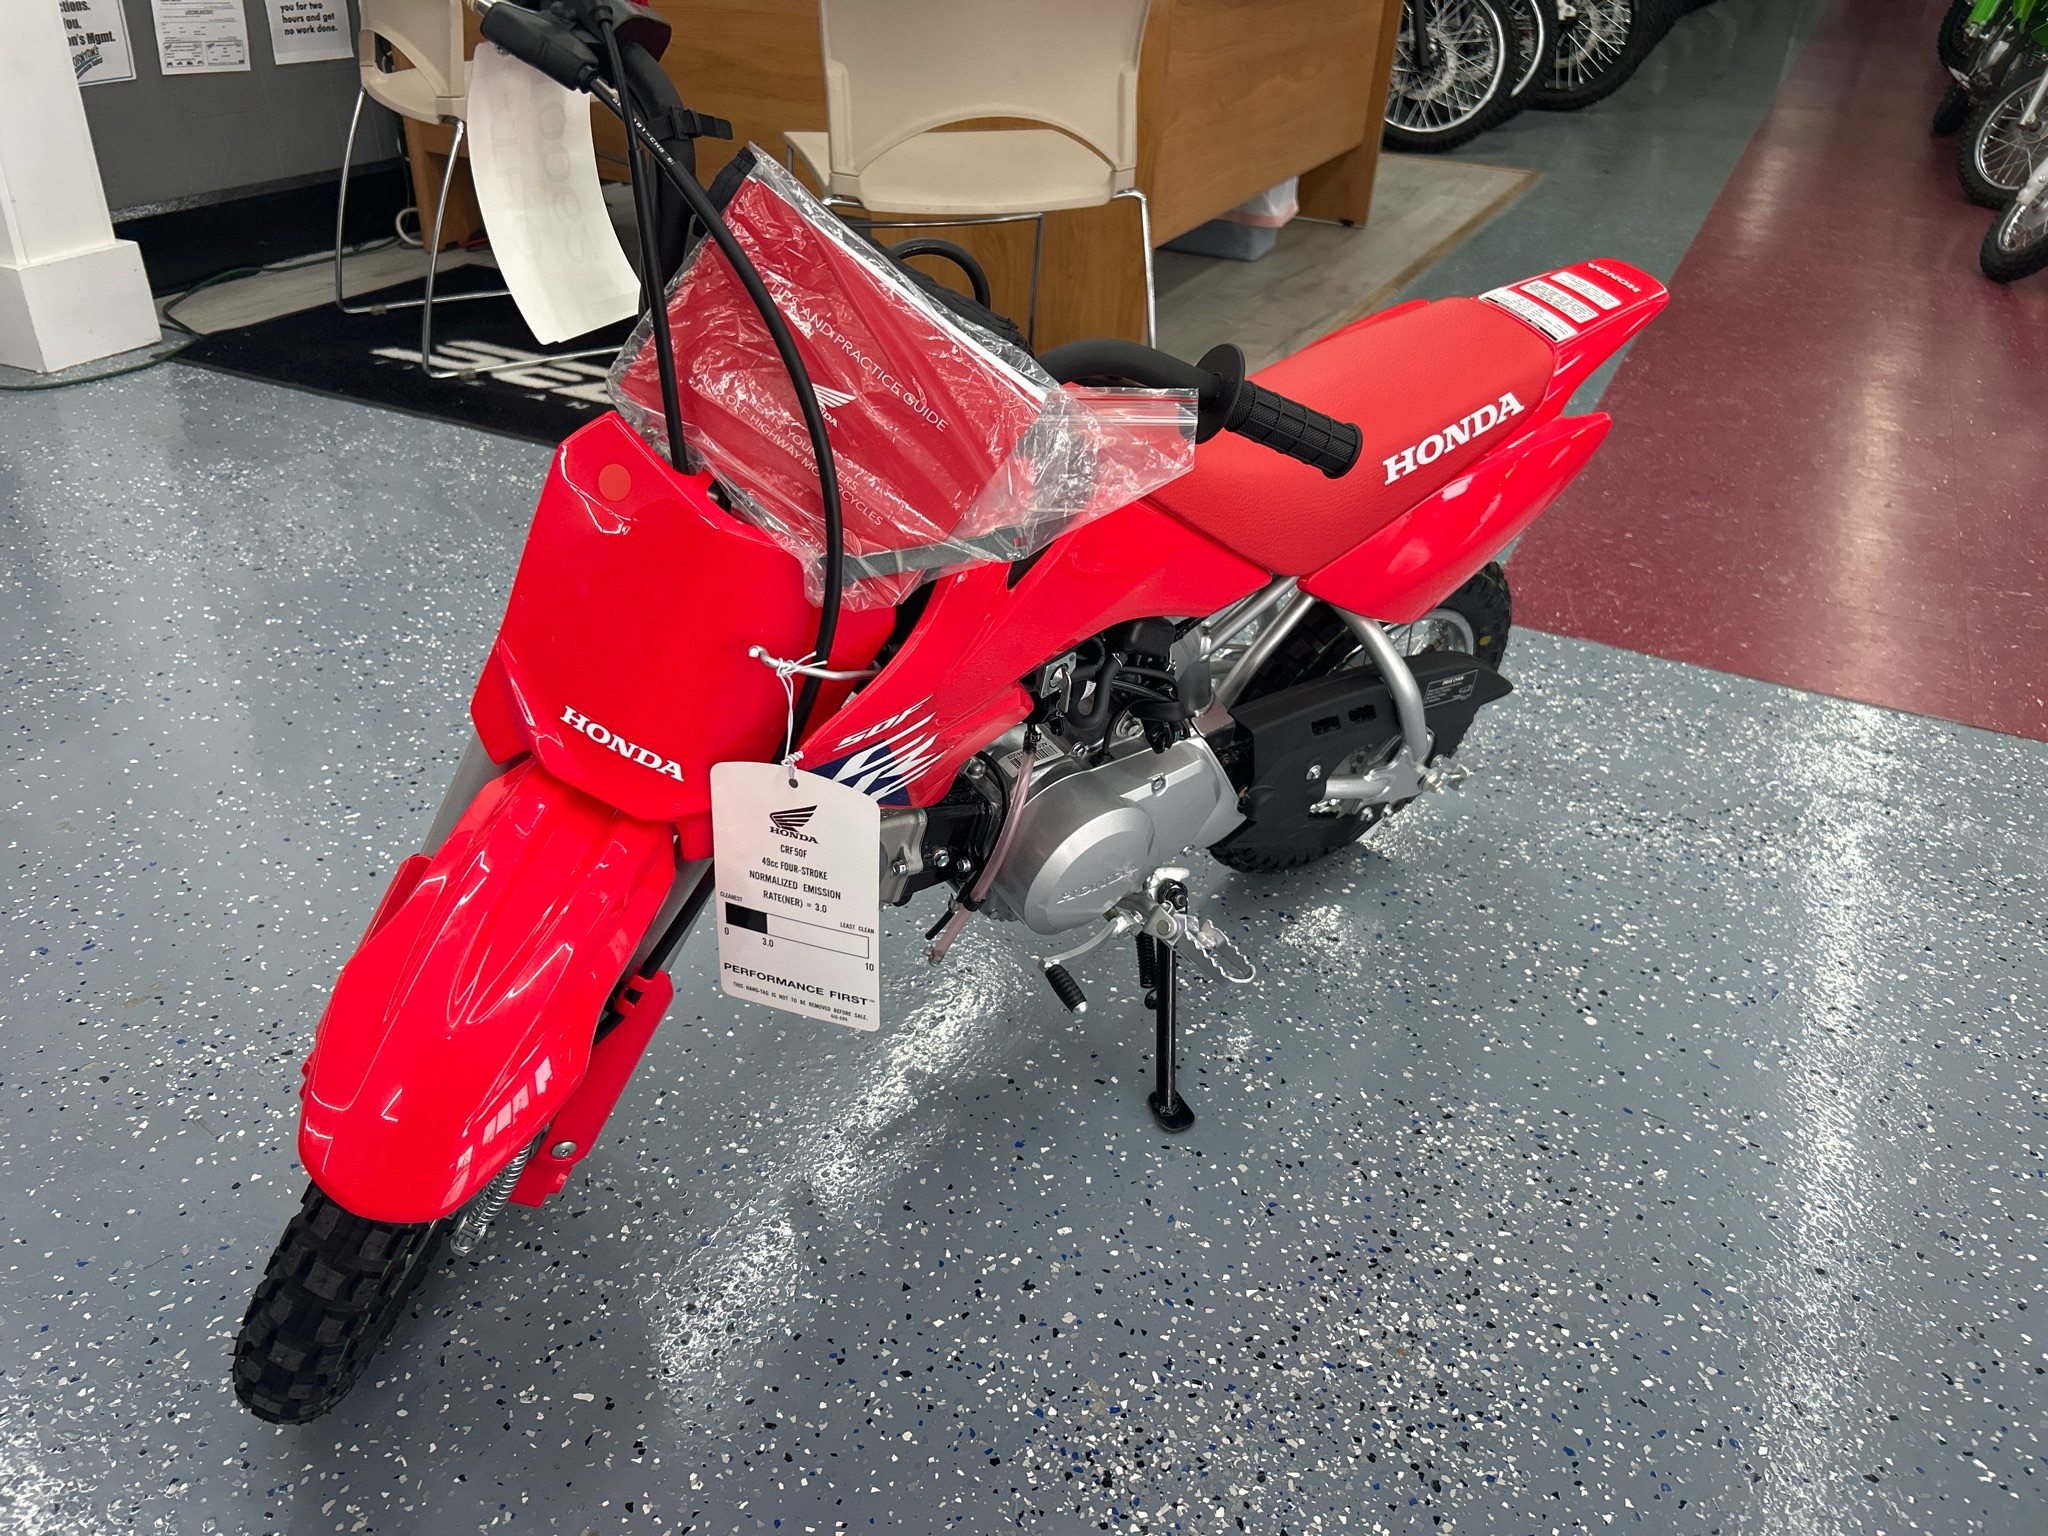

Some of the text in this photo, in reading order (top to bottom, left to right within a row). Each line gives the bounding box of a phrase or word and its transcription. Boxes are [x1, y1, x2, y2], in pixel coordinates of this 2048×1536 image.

[280, 5, 294, 13] you
[296, 2, 307, 10] for
[282, 13, 335, 23] hours and get
[86, 31, 116, 45] Mgmt.
[296, 25, 315, 34] work
[317, 24, 338, 32] done.
[1588, 262, 1641, 293] HONDA
[800, 307, 833, 337] AND
[834, 333, 903, 397] PRACTICE
[903, 391, 948, 432] GUIDE
[1383, 392, 1524, 485] HONDA
[559, 705, 685, 782] HONDA
[769, 826, 819, 844] HONDA
[761, 857, 828, 880] 49cc FOUR-STROKE
[749, 870, 841, 900] NORMALIZED EMISSION
[720, 891, 743, 902] CLEANEST
[763, 890, 804, 908] RATE(NER)
[815, 903, 827, 913] 3.0
[724, 927, 729, 935] 0
[840, 922, 875, 934] LEAST CLEAN
[762, 938, 774, 948] 3.0
[865, 962, 875, 972] 10
[724, 962, 824, 996] PERFORMANCE
[746, 985, 769, 996] HANG-TAG
[808, 1002, 831, 1012] REMOVED
[833, 1008, 852, 1017] BEFORE
